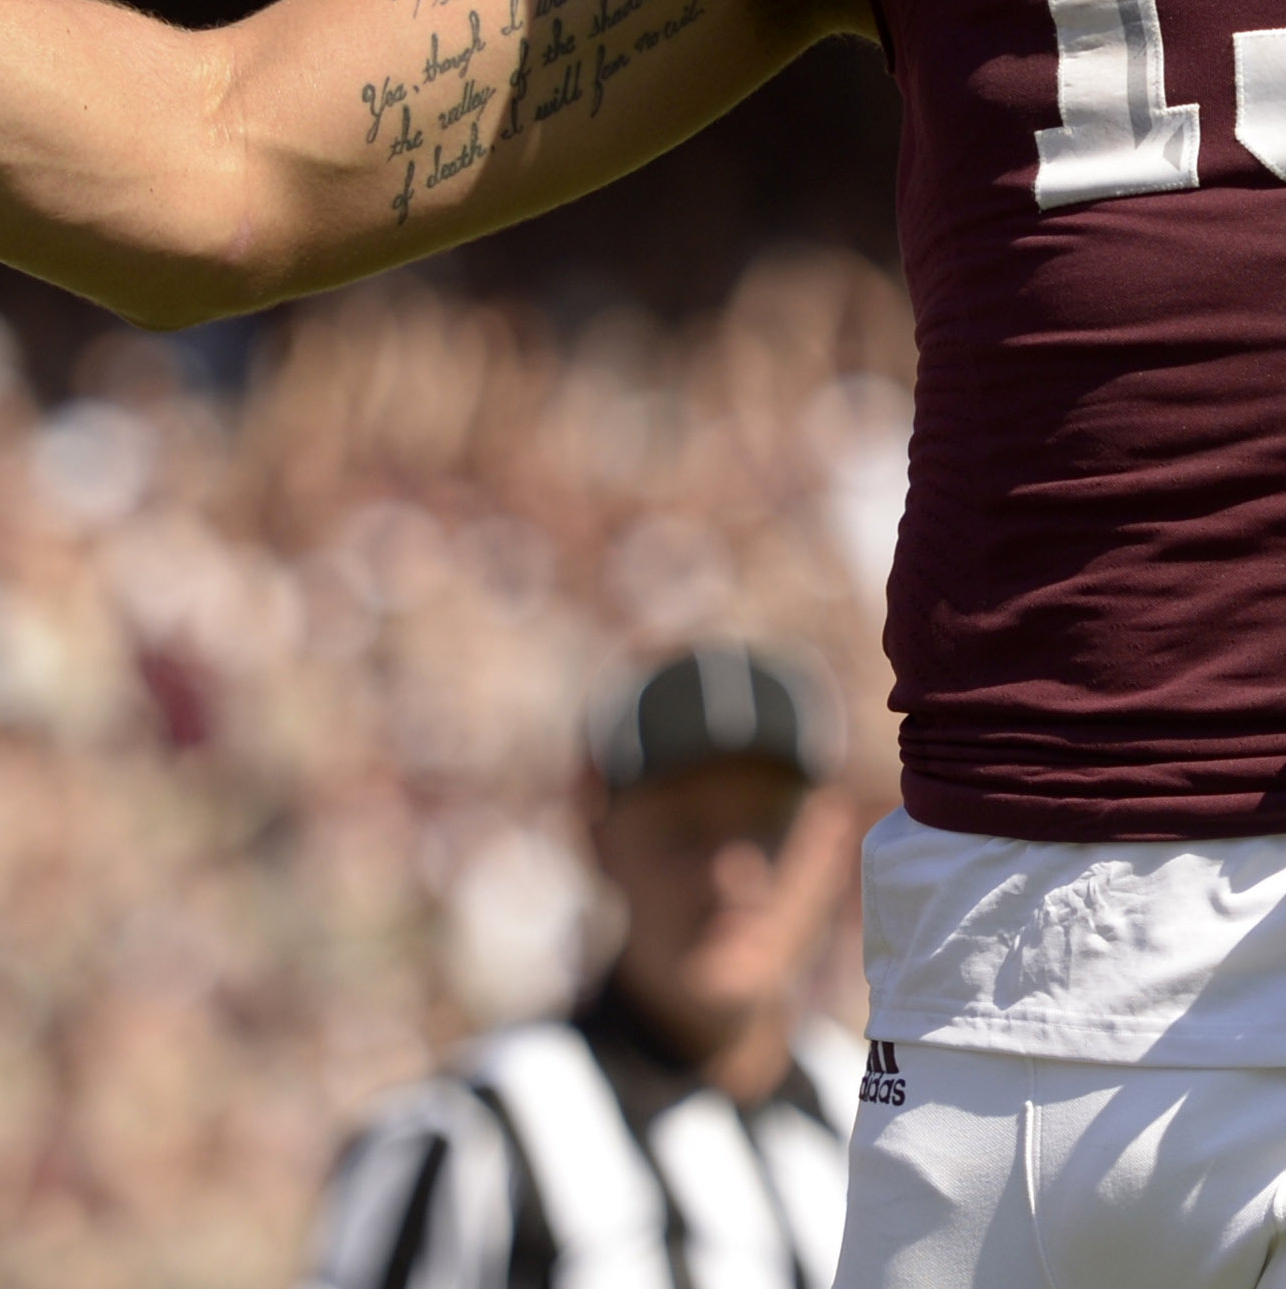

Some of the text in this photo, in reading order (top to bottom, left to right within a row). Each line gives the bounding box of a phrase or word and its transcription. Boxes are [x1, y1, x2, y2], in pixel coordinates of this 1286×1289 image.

[387, 105, 425, 162] the
[438, 80, 497, 130] valley
[510, 38, 532, 100] of
[543, 18, 576, 67] the
[423, 10, 486, 84] though
[392, 160, 415, 225] of
[534, 60, 583, 121] will
[590, 44, 631, 118] fear
[634, 28, 662, 53] no
